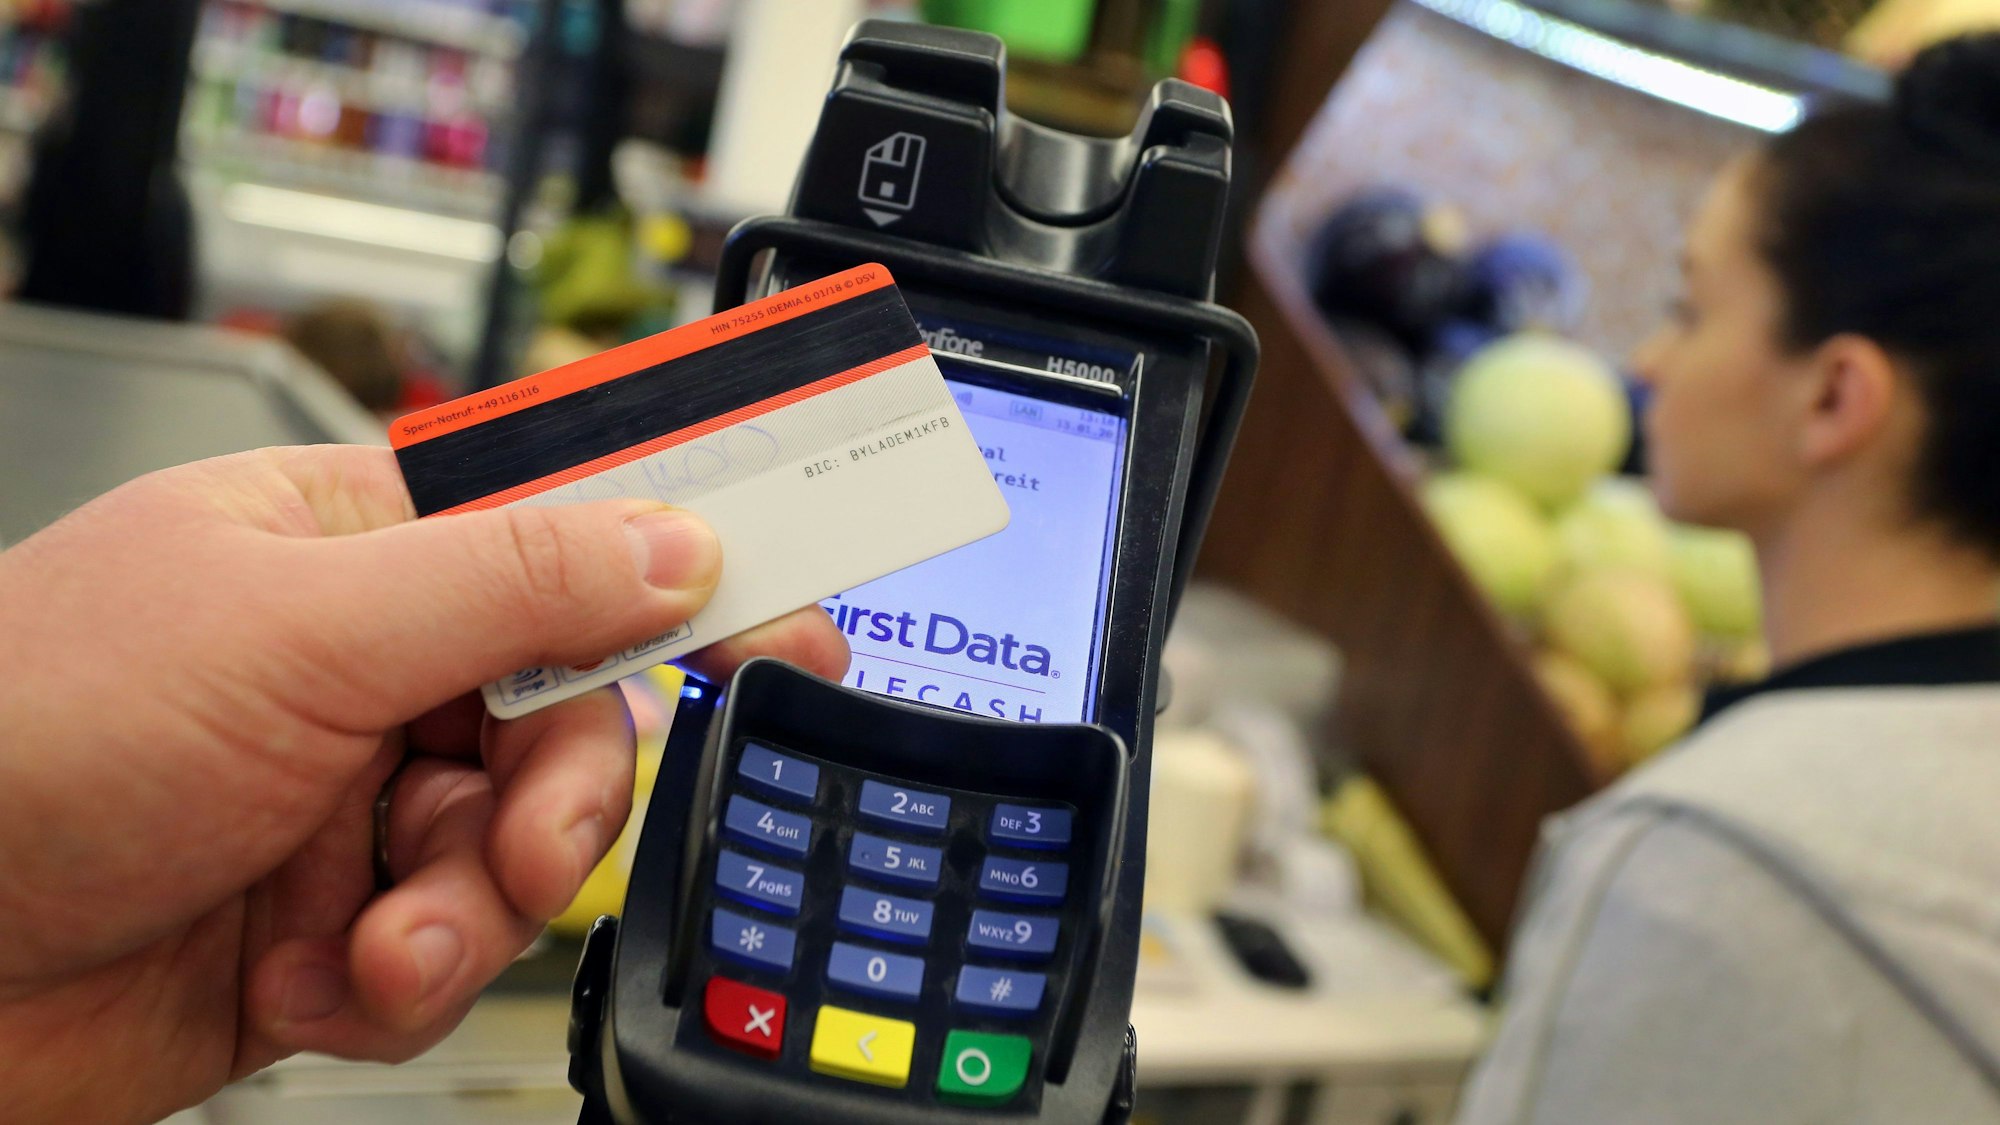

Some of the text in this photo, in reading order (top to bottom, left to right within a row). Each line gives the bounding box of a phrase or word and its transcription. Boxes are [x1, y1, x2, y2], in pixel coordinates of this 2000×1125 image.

[711, 320, 731, 335] HIN
[732, 310, 765, 327] 75255
[767, 297, 804, 316] IDEMIA
[804, 293, 812, 303] 6
[813, 283, 842, 300] 01/18
[855, 272, 876, 285] DSV
[1046, 355, 1115, 384] H5000
[403, 384, 540, 436] Sperr-Notruf: +49 116 116
[1014, 402, 1038, 417] LAN
[804, 459, 840, 478] BIC:
[849, 416, 950, 462] BYLADEM1KFB
[994, 472, 1040, 491] reit
[823, 594, 917, 648] irst
[772, 760, 783, 781] 1
[890, 791, 935, 816] 2 ABC
[757, 811, 799, 839] 4 GHI
[1000, 811, 1041, 834] DEF 3
[884, 845, 927, 870] 5 JKL
[873, 899, 919, 924] 8 TUV
[979, 920, 1032, 944] WXYZ 9
[867, 956, 887, 982] 0
